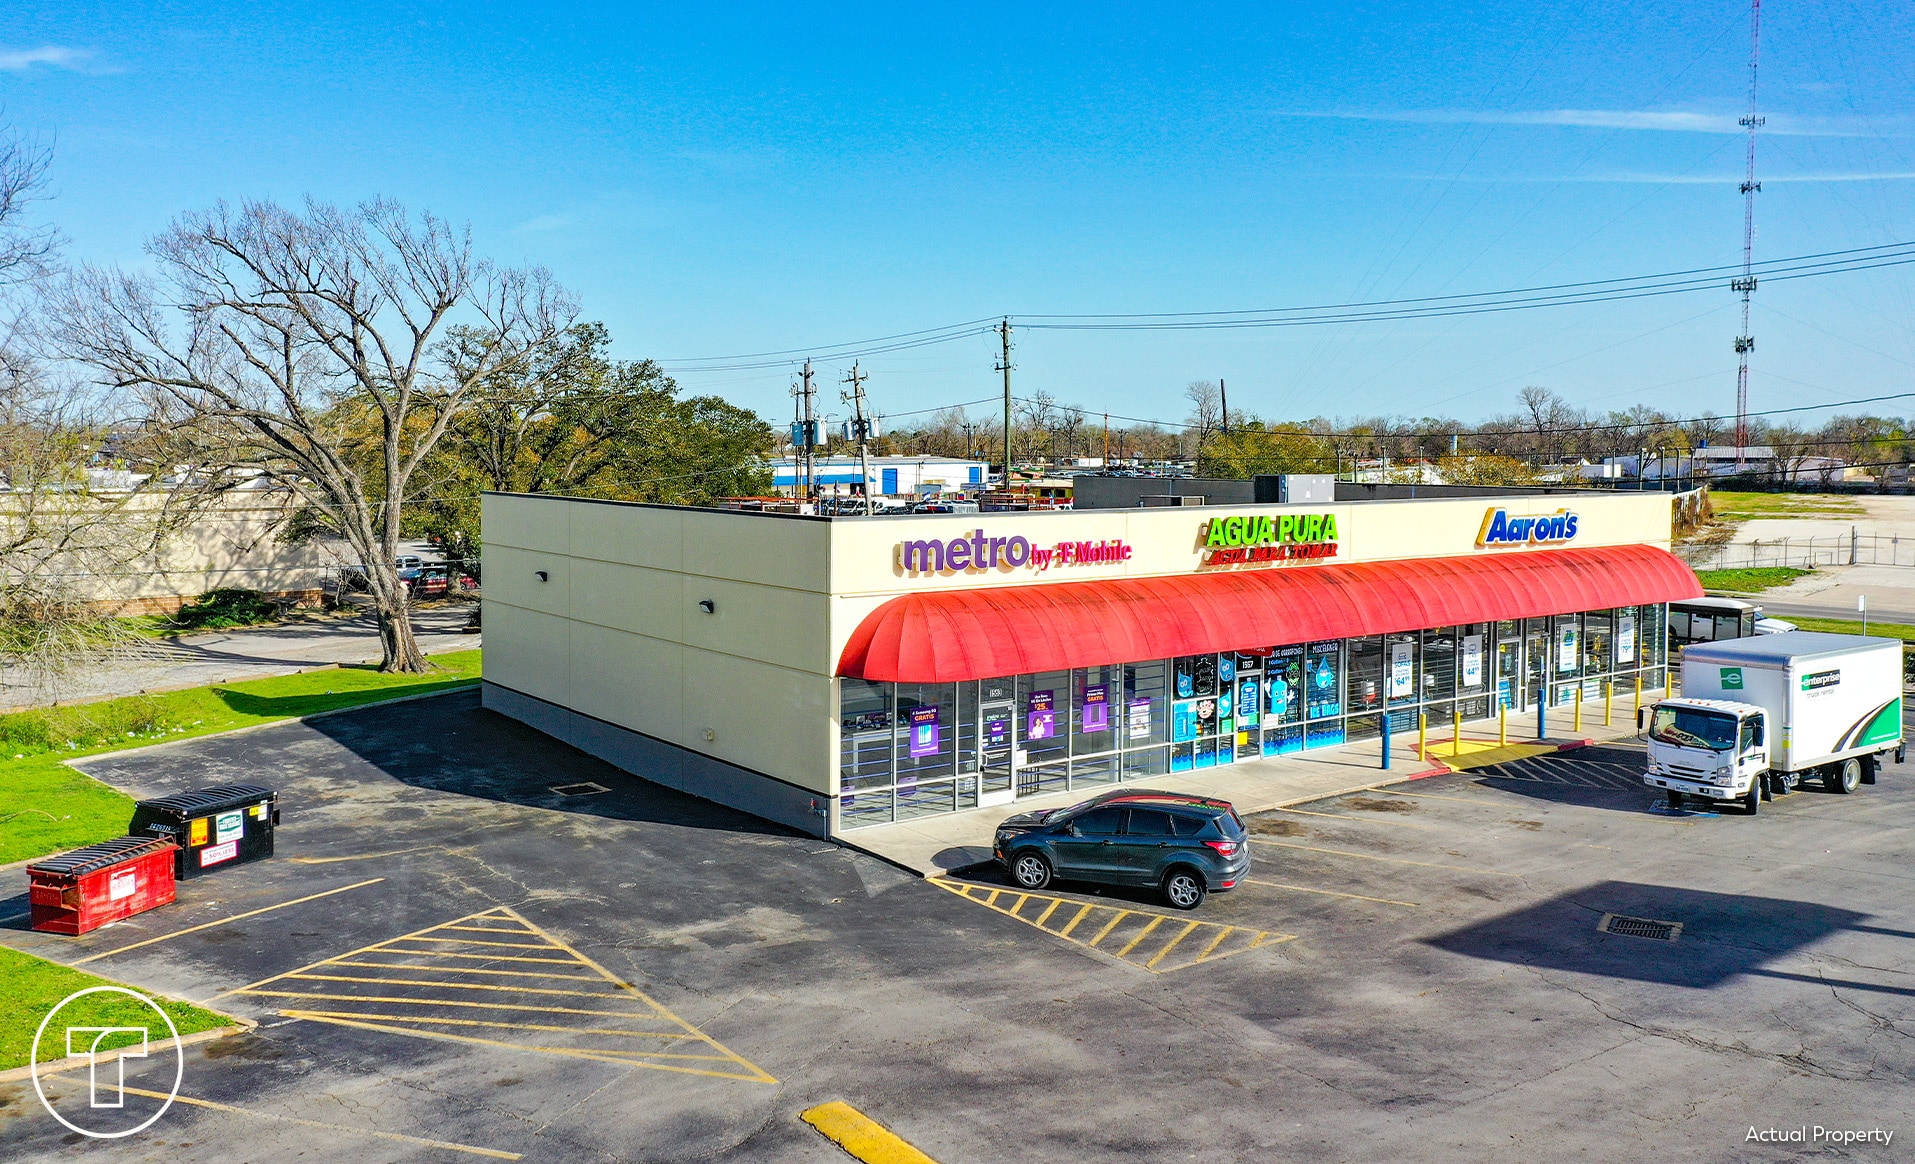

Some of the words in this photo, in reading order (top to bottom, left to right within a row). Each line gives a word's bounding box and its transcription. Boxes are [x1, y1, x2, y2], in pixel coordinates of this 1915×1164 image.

[1206, 516, 1275, 547] AGUA
[1279, 513, 1339, 543] PURA
[1485, 510, 1579, 542] Aaron's
[902, 528, 1030, 572] metro
[1031, 543, 1054, 572] by
[1209, 548, 1248, 566] AGUA
[1291, 542, 1339, 561] TOMAR
[1394, 659, 1411, 669] SOFAS
[1802, 672, 1841, 687] enterprise
[1806, 690, 1820, 698] truck
[1820, 687, 1835, 696] rental
[914, 714, 935, 722] GRATIS
[1309, 705, 1321, 719] ICE
[1321, 702, 1340, 717] BAGS
